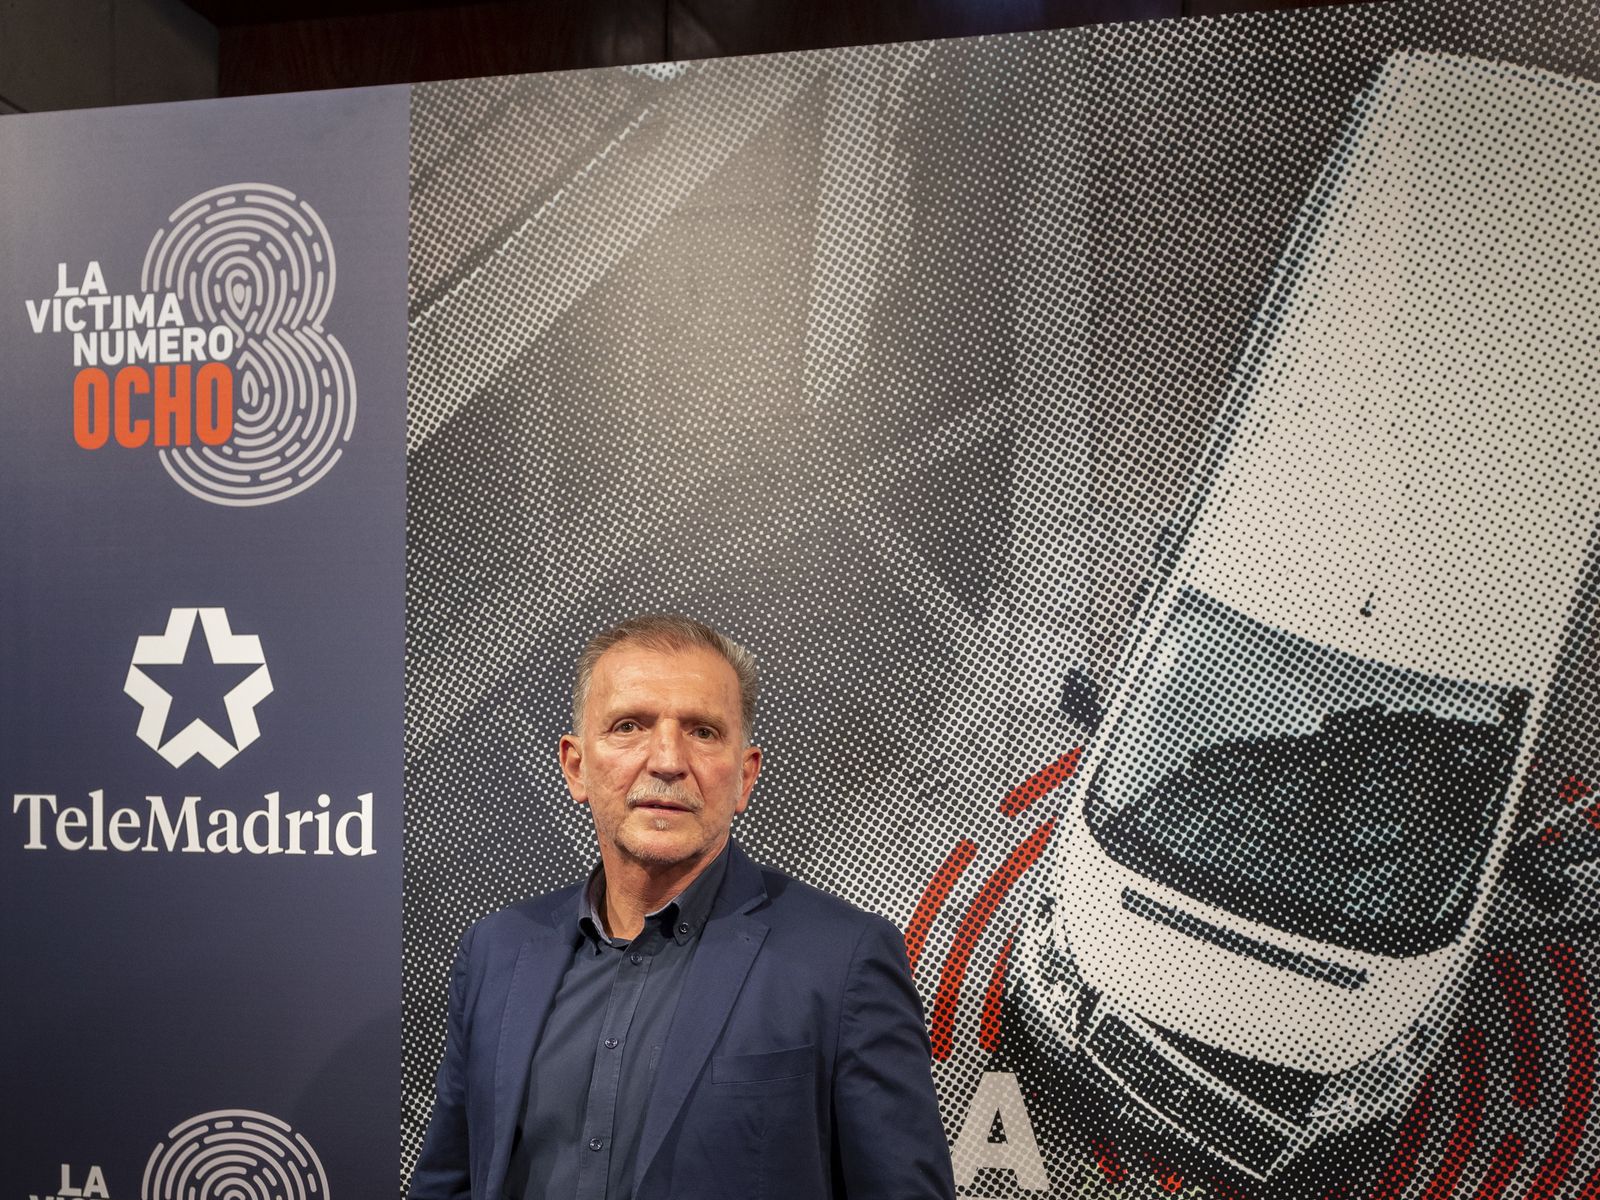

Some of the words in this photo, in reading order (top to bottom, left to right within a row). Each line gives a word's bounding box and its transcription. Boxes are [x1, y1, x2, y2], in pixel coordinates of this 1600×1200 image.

[54, 261, 108, 297] LA
[73, 362, 234, 450] OCHO
[13, 788, 378, 857] TeleMadrid
[57, 1163, 110, 1199] LA
